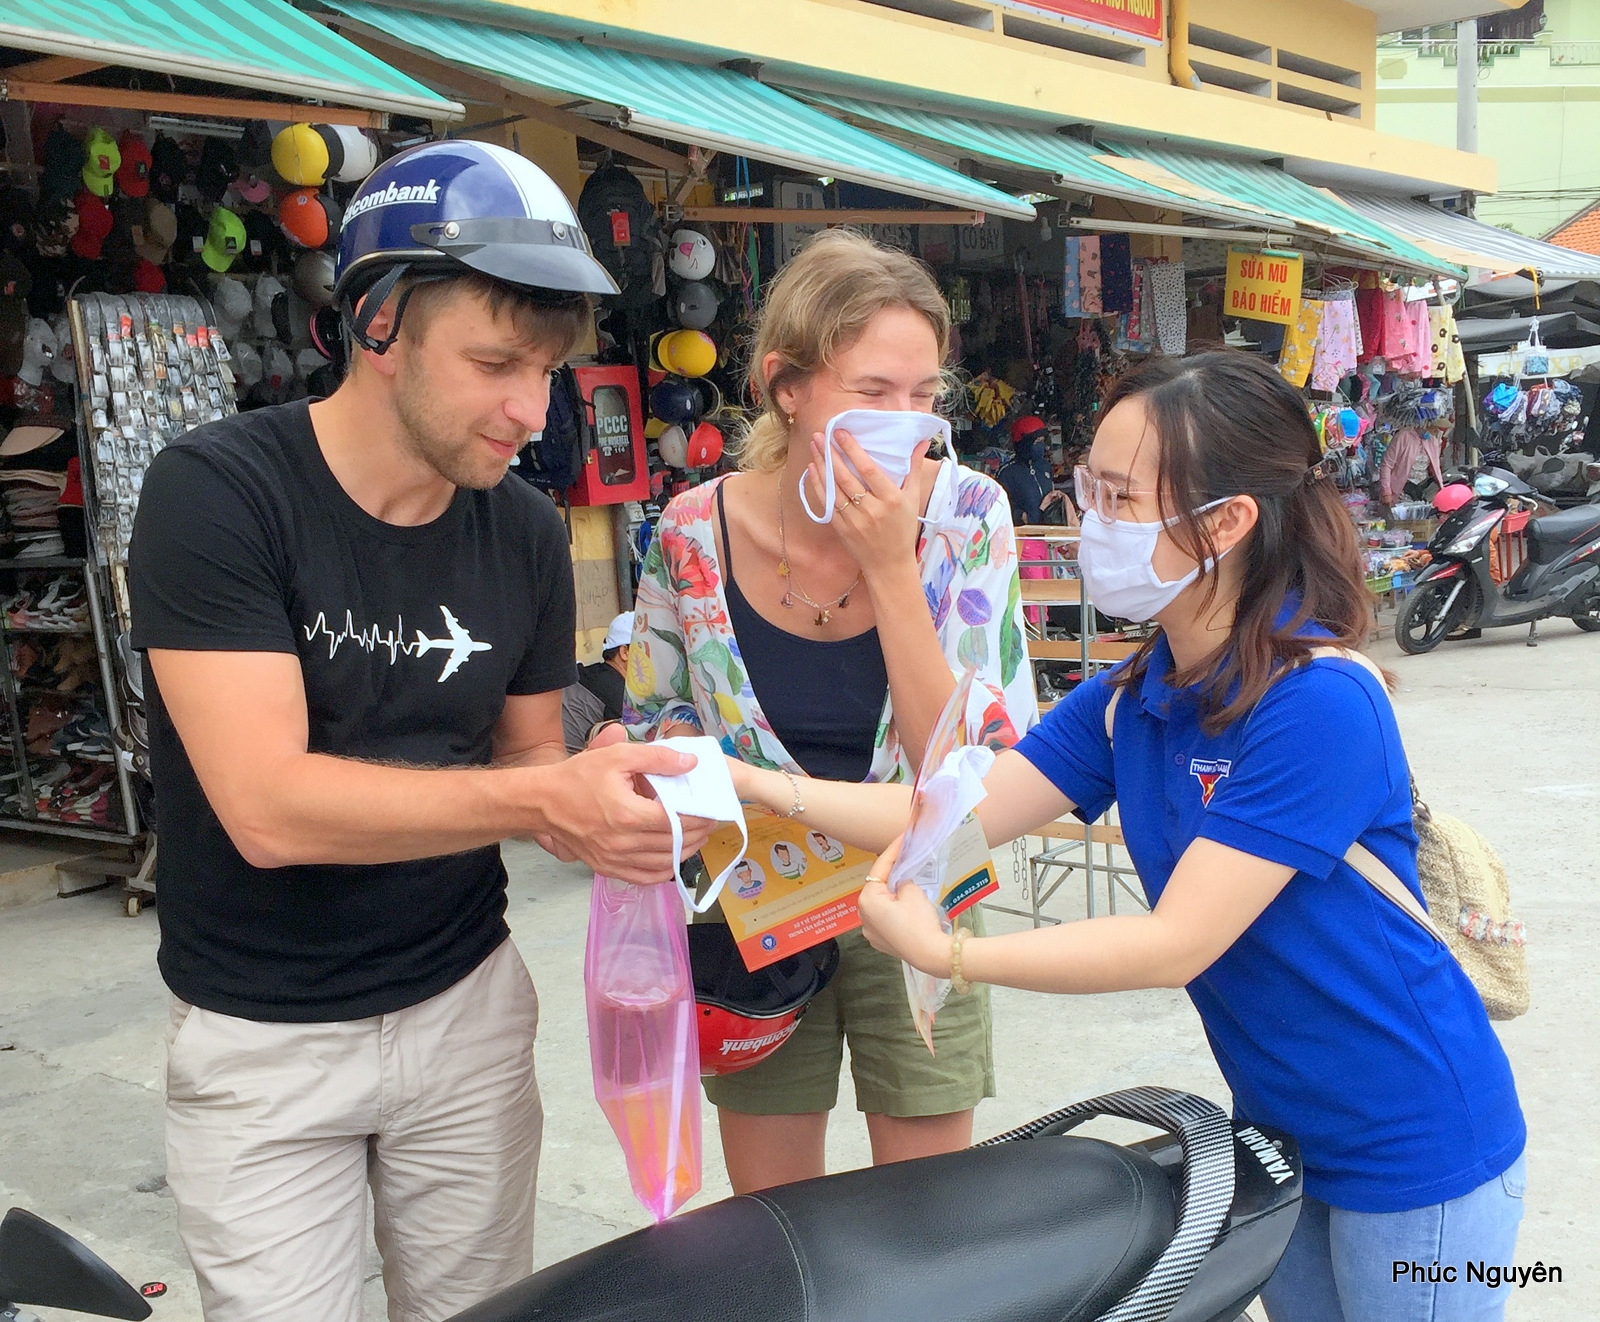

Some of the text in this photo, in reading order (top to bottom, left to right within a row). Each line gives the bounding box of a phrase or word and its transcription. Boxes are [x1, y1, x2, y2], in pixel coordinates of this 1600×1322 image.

[1240, 255, 1288, 283] SỬA MŨ
[1232, 286, 1291, 316] BẢO HIỂM
[596, 415, 628, 435] PCCC
[1235, 1126, 1295, 1184] YAMAHA
